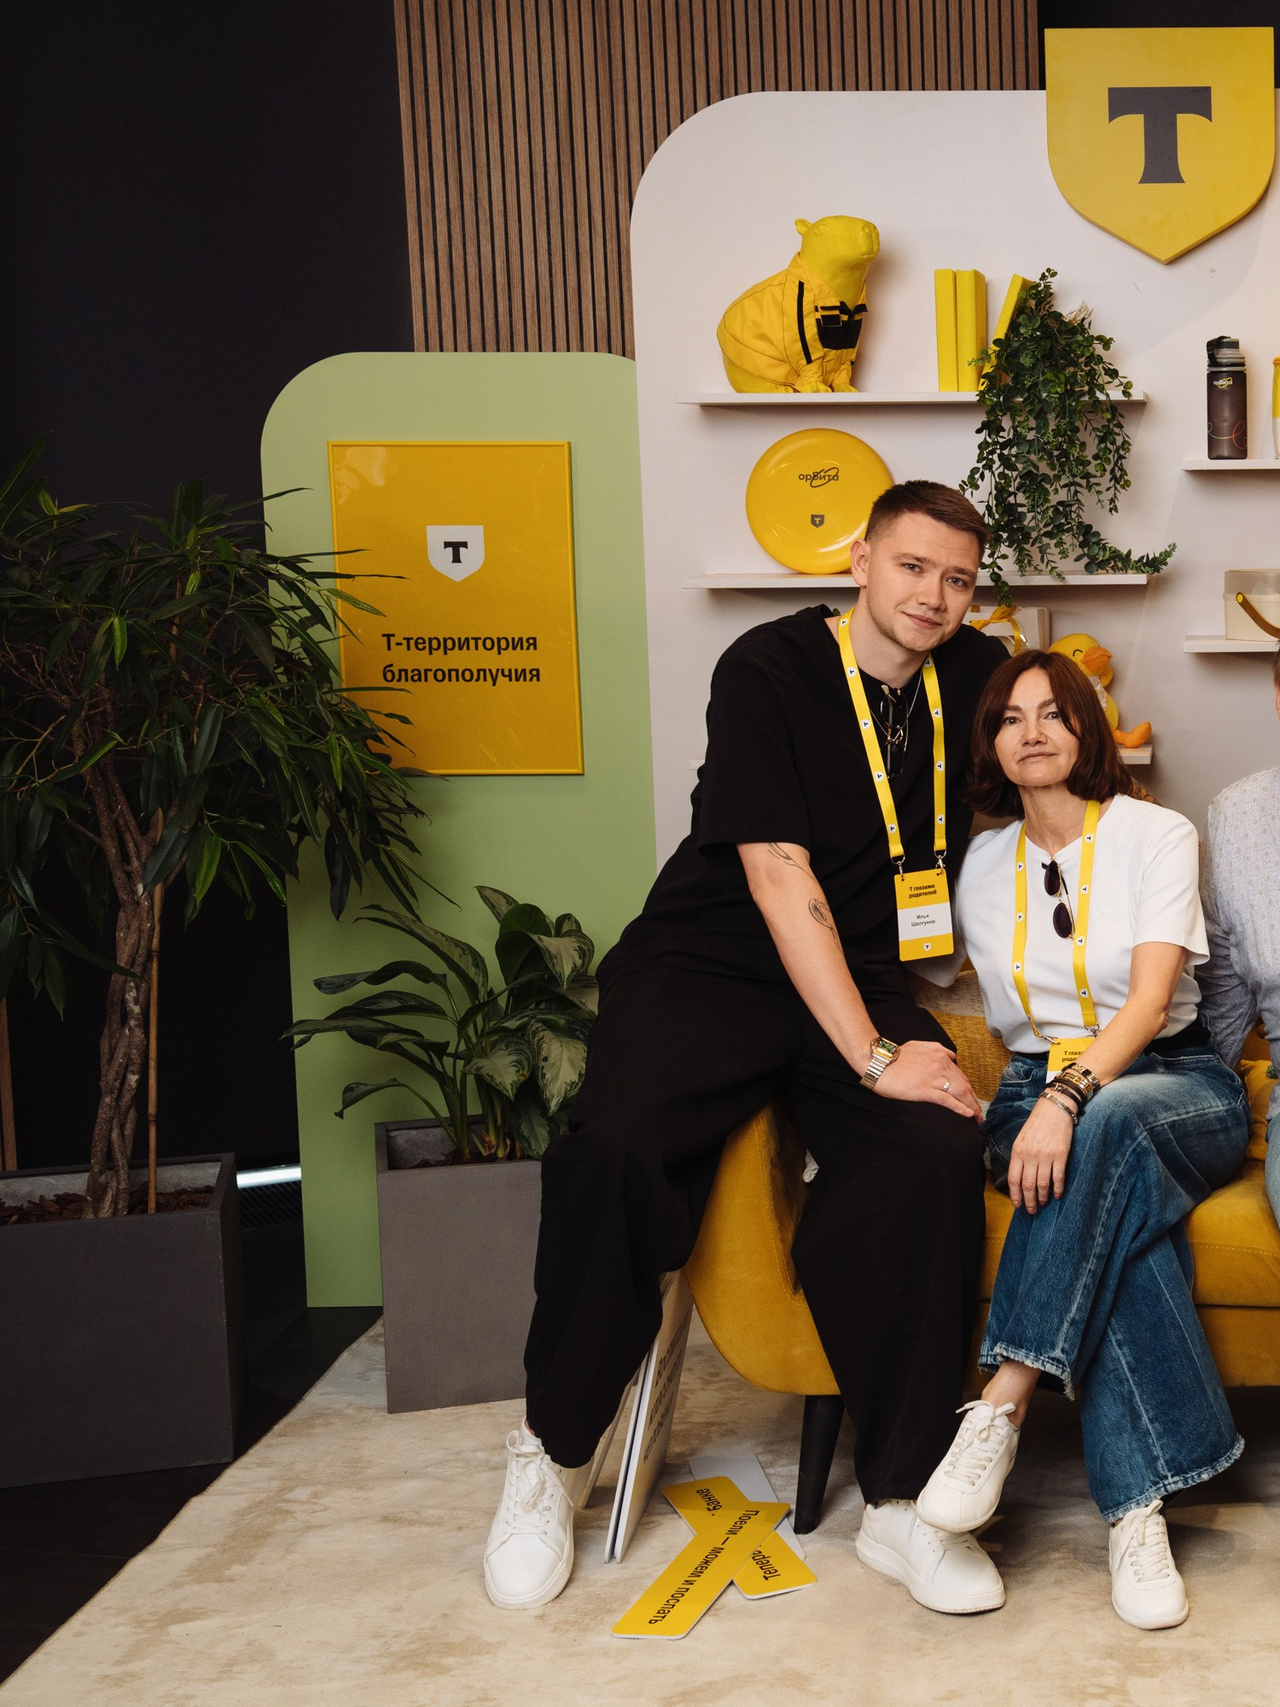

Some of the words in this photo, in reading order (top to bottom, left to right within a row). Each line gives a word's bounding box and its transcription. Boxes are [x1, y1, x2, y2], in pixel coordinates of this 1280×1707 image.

[1107, 86, 1213, 184] Т
[798, 470, 839, 484] орбита
[443, 540, 469, 564] Т
[381, 633, 538, 656] Т-территория
[382, 663, 541, 687] благополучия
[909, 889, 937, 899] родителей
[725, 1509, 760, 1536] Поели
[688, 1546, 725, 1579] можем
[681, 1579, 697, 1588] и
[648, 1587, 690, 1625] поспать
